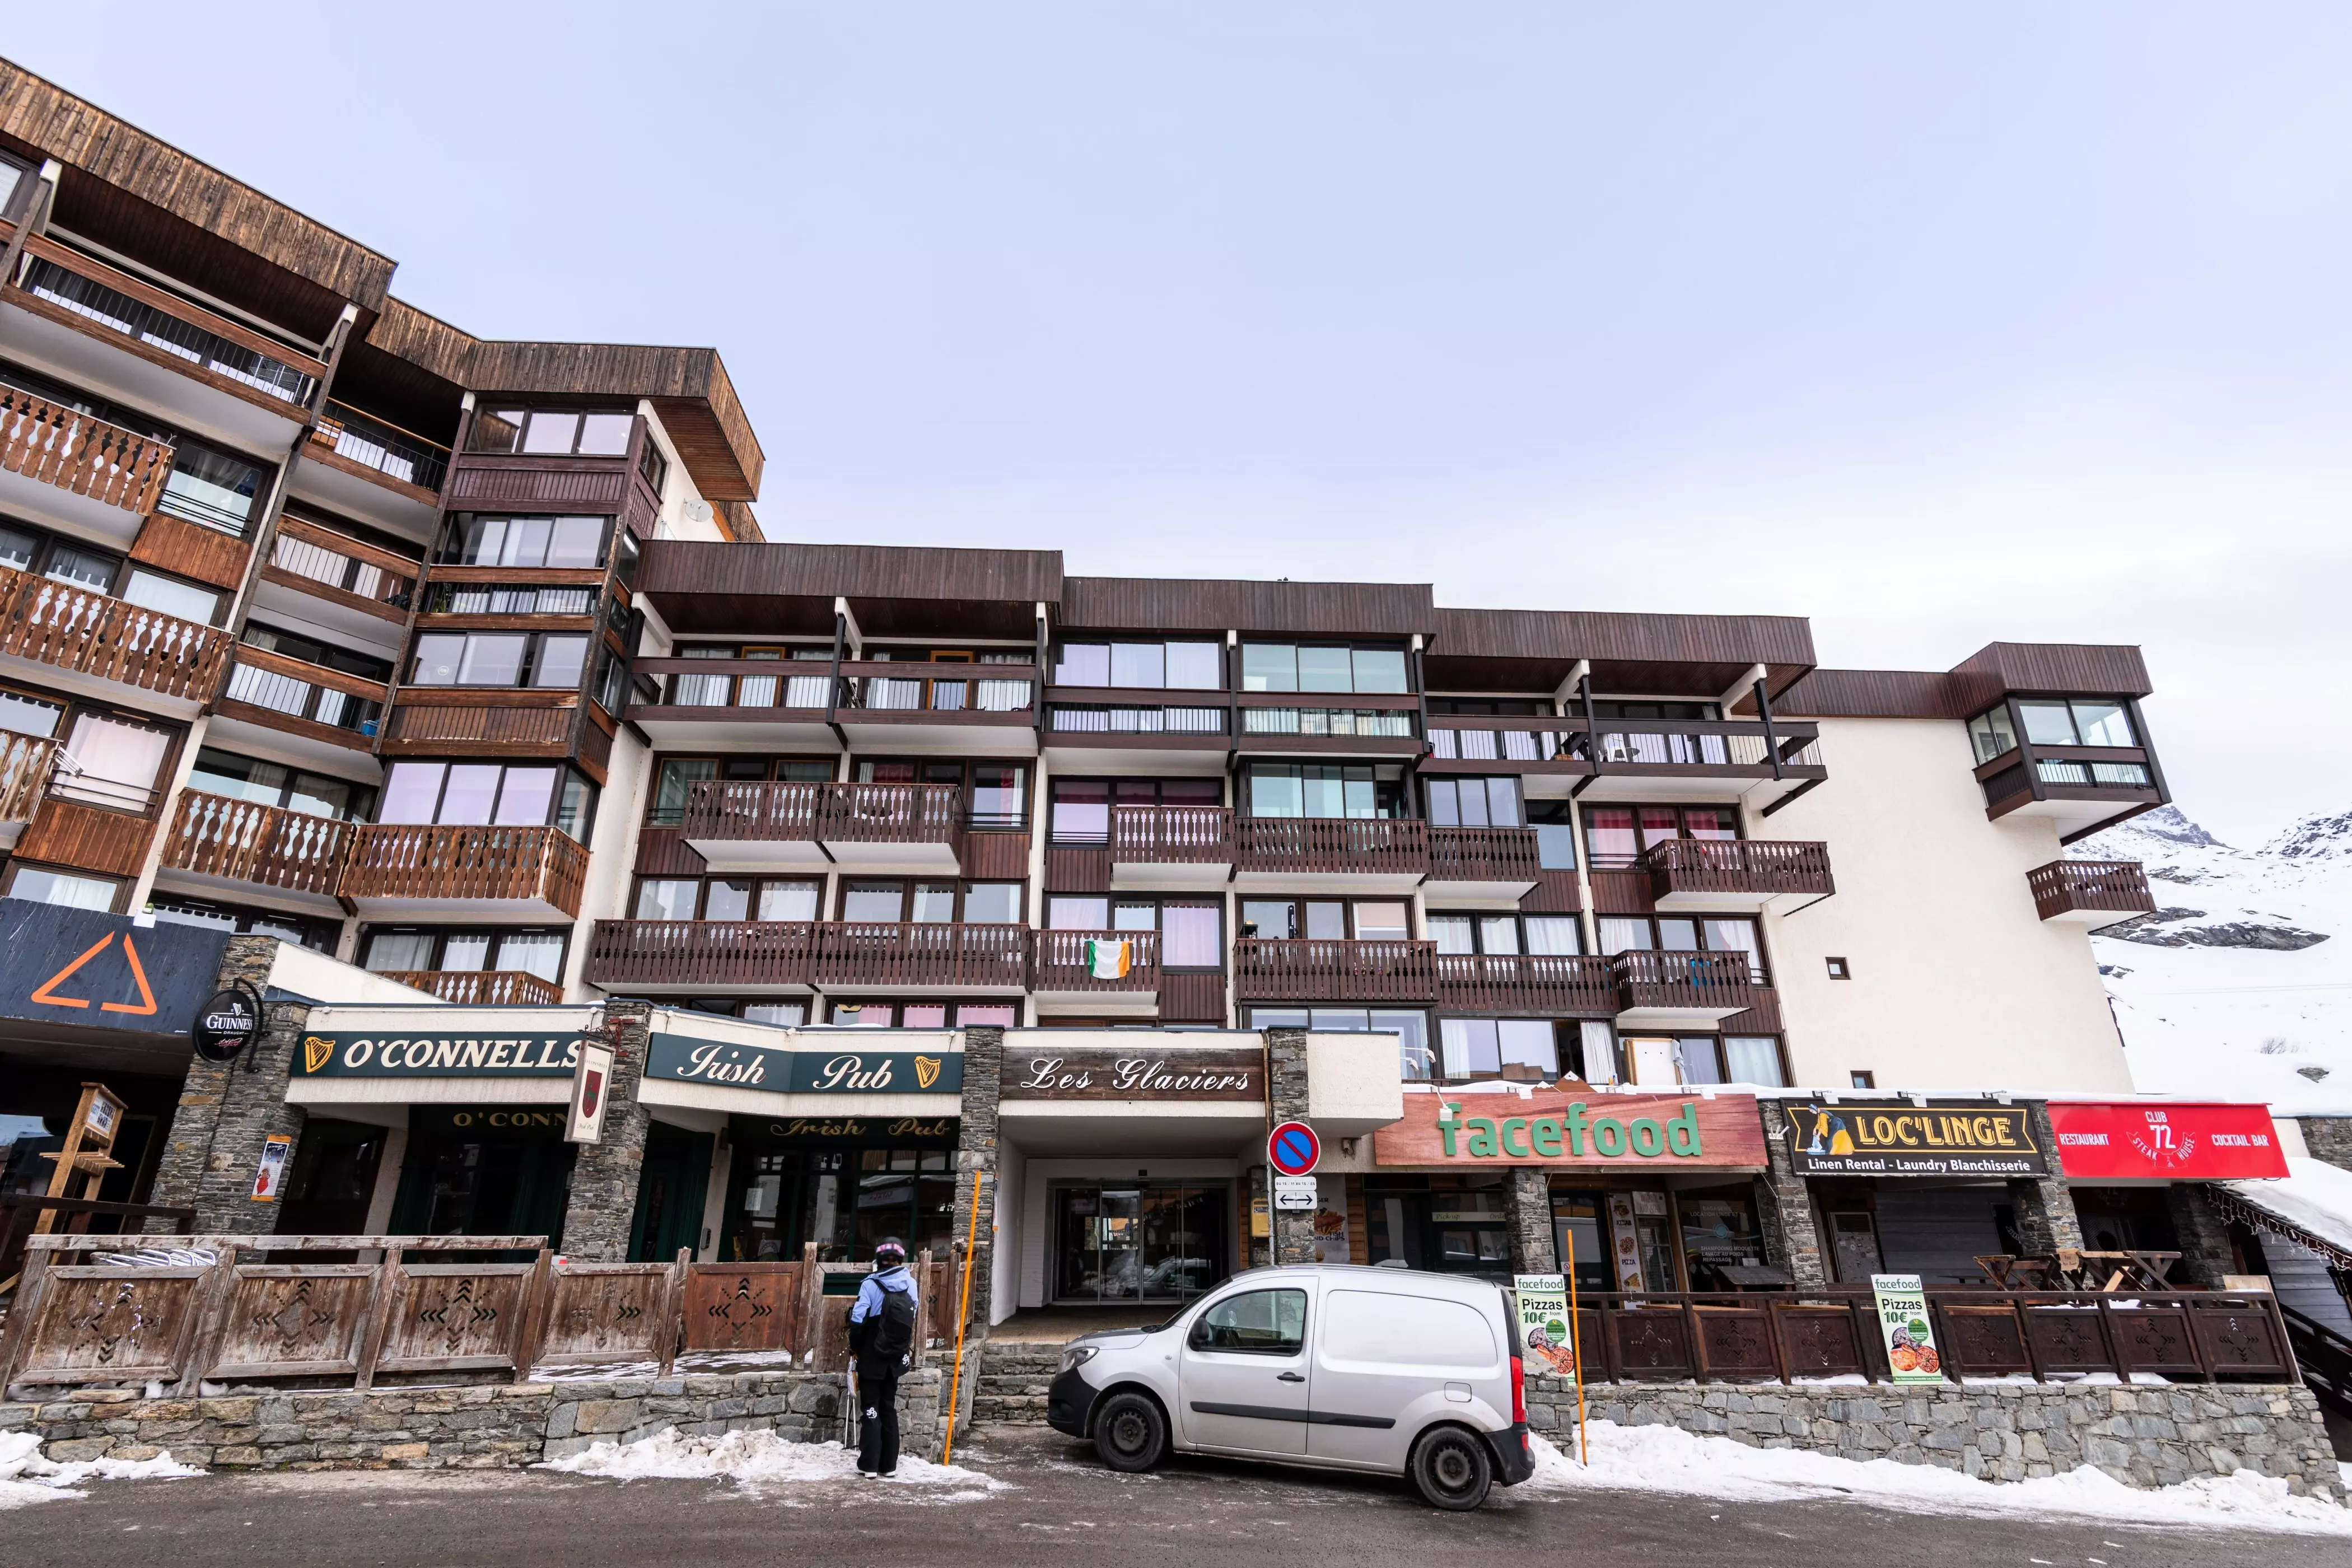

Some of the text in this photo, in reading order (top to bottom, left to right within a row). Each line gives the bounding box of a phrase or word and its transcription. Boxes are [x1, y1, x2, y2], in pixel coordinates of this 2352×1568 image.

[207, 1015, 253, 1030] GUINNESS
[344, 1039, 580, 1067] O'CONNELLS
[676, 1045, 893, 1089] Irish Pub
[1020, 1058, 1248, 1090] Les Glaciers
[2144, 1111, 2167, 1123] CLUB
[771, 1117, 950, 1136] Irish Pub
[1438, 1102, 1703, 1156] facefood
[1855, 1116, 2016, 1146] LOC'LINGE
[2059, 1133, 2109, 1146] RESTAURANT
[2149, 1124, 2176, 1149] 72
[2211, 1135, 2269, 1146] COCKTAIL BAR
[2132, 1137, 2196, 1161] STEAK HOUSE
[1808, 1159, 1842, 1170] Linen
[1845, 1159, 1886, 1170] Rental
[1897, 1159, 1947, 1173] Laundry
[1951, 1159, 2031, 1172] Blanchisserie
[1518, 1278, 1564, 1289] facefood
[1875, 1278, 1920, 1289] facefood
[1522, 1299, 1563, 1310] Pizzas
[1882, 1299, 1922, 1310] Pizzas
[1523, 1312, 1547, 1323] 10€
[1884, 1311, 1907, 1323] 10€
